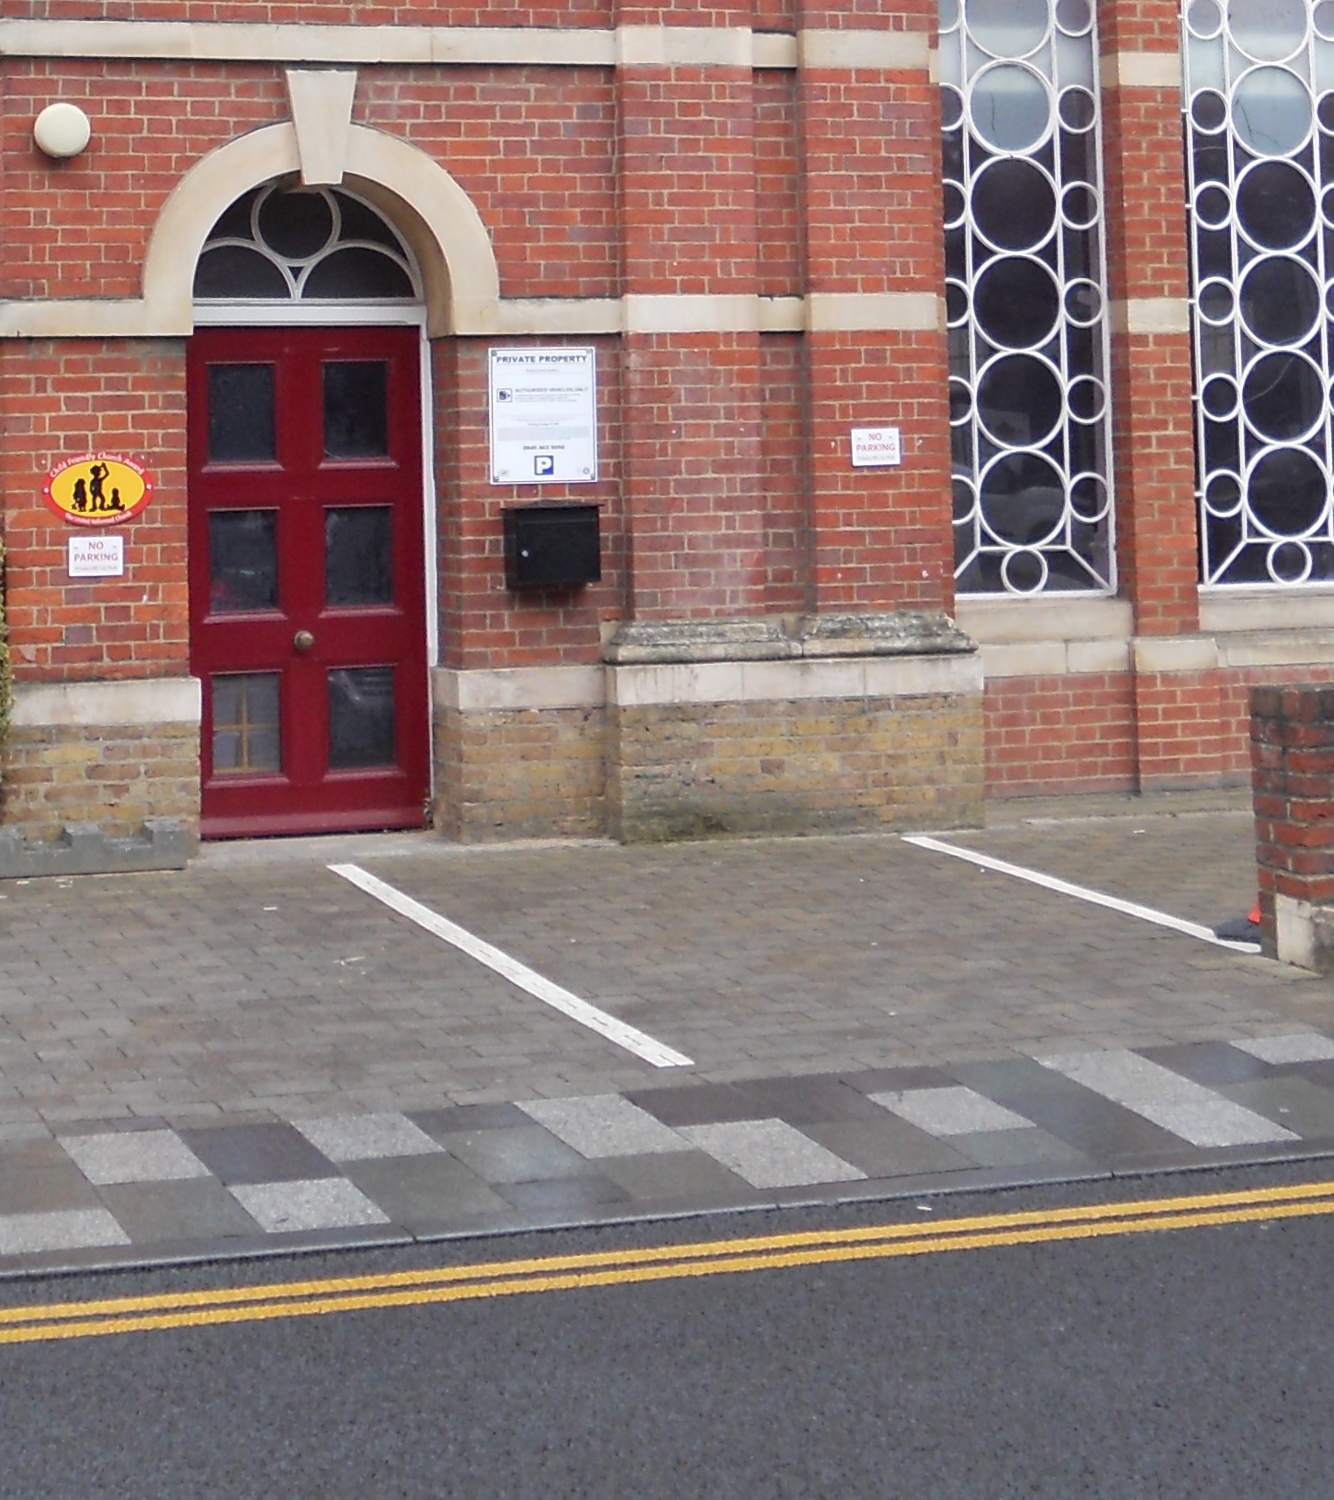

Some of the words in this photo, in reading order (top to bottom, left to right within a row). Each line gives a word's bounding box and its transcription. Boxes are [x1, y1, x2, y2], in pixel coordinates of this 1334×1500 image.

[496, 355, 536, 363] PRIVATE
[538, 355, 587, 363] PROPERTY
[868, 433, 882, 441] NO
[857, 443, 895, 451] PARKING
[88, 541, 104, 550] NO
[74, 553, 118, 562] PARKING
